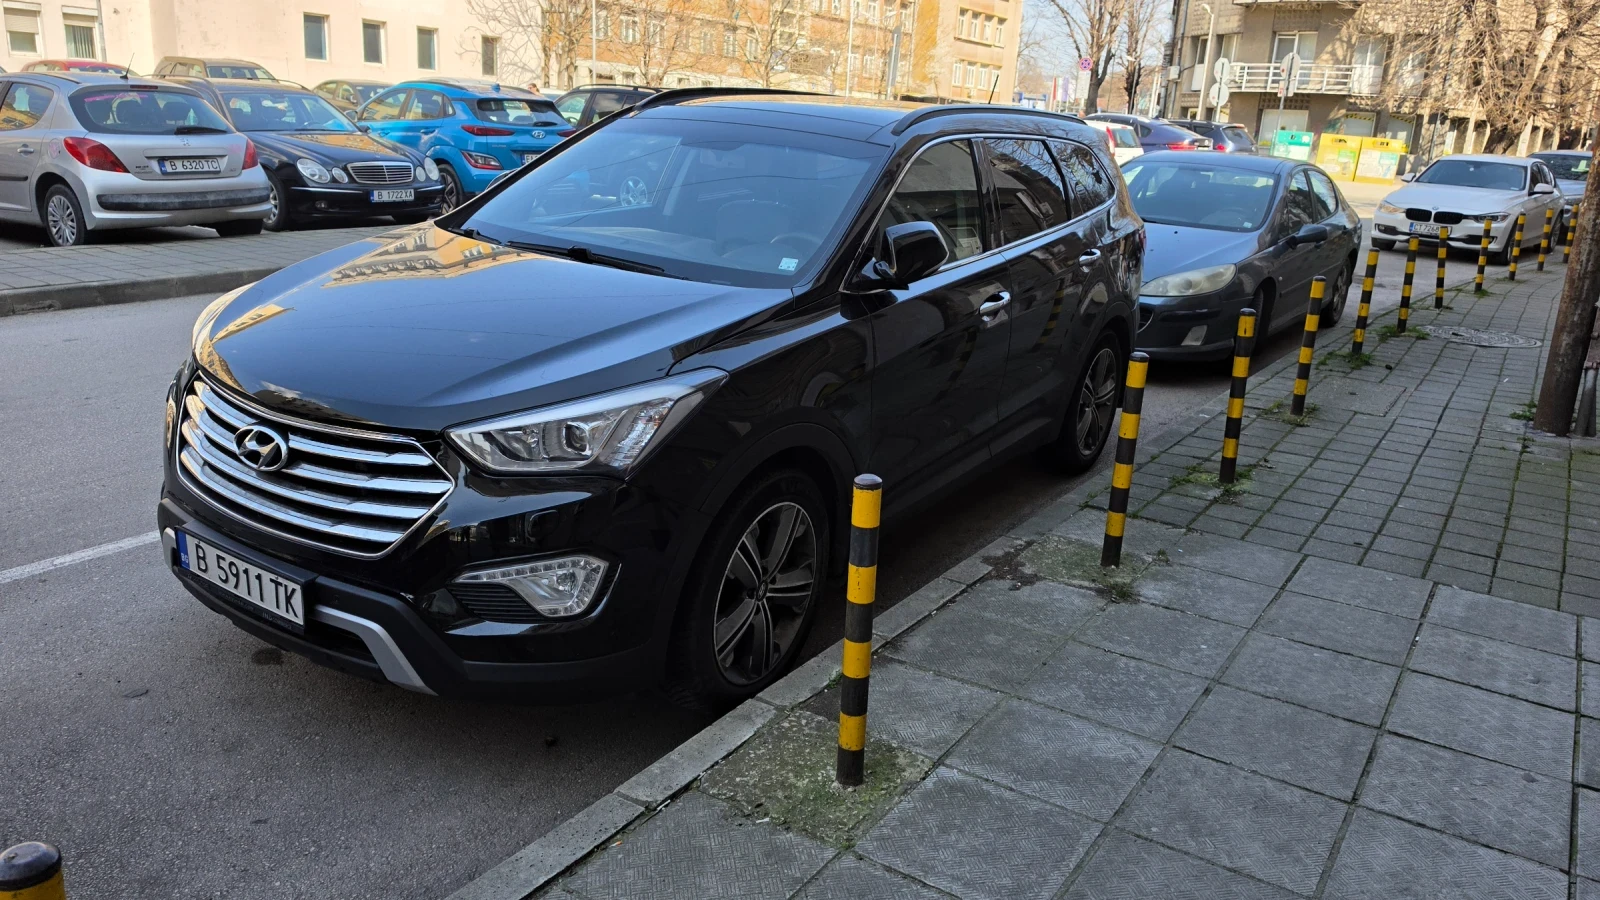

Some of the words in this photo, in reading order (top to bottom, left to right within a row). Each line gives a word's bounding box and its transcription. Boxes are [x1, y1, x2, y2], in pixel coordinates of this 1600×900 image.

[170, 161, 177, 171] B
[377, 191, 383, 200] B
[195, 543, 208, 573] B
